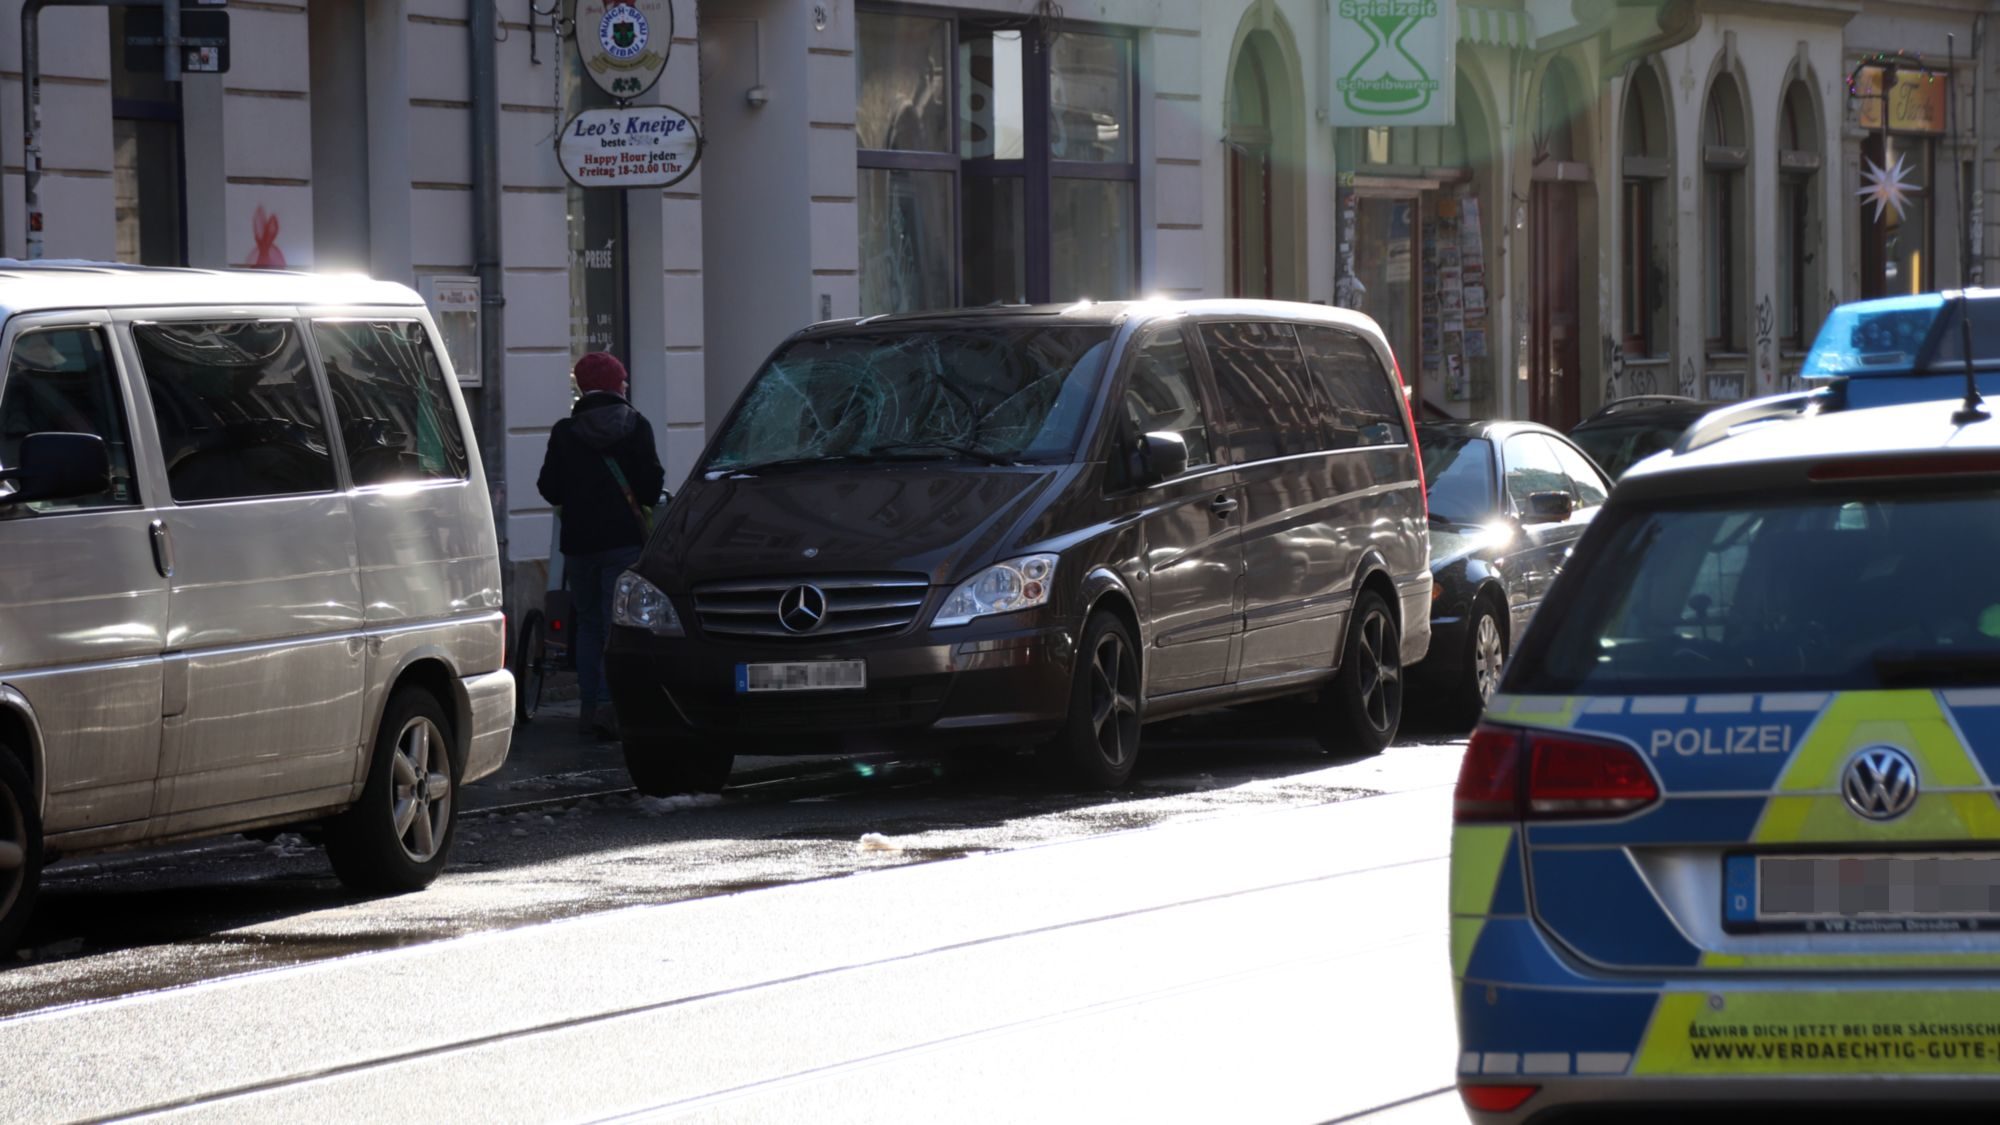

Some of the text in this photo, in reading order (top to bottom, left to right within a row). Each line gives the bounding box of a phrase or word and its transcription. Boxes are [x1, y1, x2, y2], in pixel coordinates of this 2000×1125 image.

[1341, 0, 1437, 21] Spielzeit
[609, 43, 640, 57] EIBAU
[1338, 79, 1438, 91] Schreibwaren
[575, 116, 686, 137] Leo's Kneipe
[601, 137, 627, 148] beste
[584, 150, 677, 166] Happy Hour jeden
[579, 163, 682, 178] Freitag 18-20.00 Uhr
[584, 249, 612, 269] PREISE
[1651, 725, 1791, 757] POLIZEI
[1734, 895, 1747, 911] D
[1823, 919, 1960, 931] VW Zentrum Dresden
[1752, 1024, 1788, 1037] DICH
[1793, 1024, 1837, 1039] JETZT
[1843, 1024, 1867, 1037] BEI
[1873, 1023, 1903, 1037] DER
